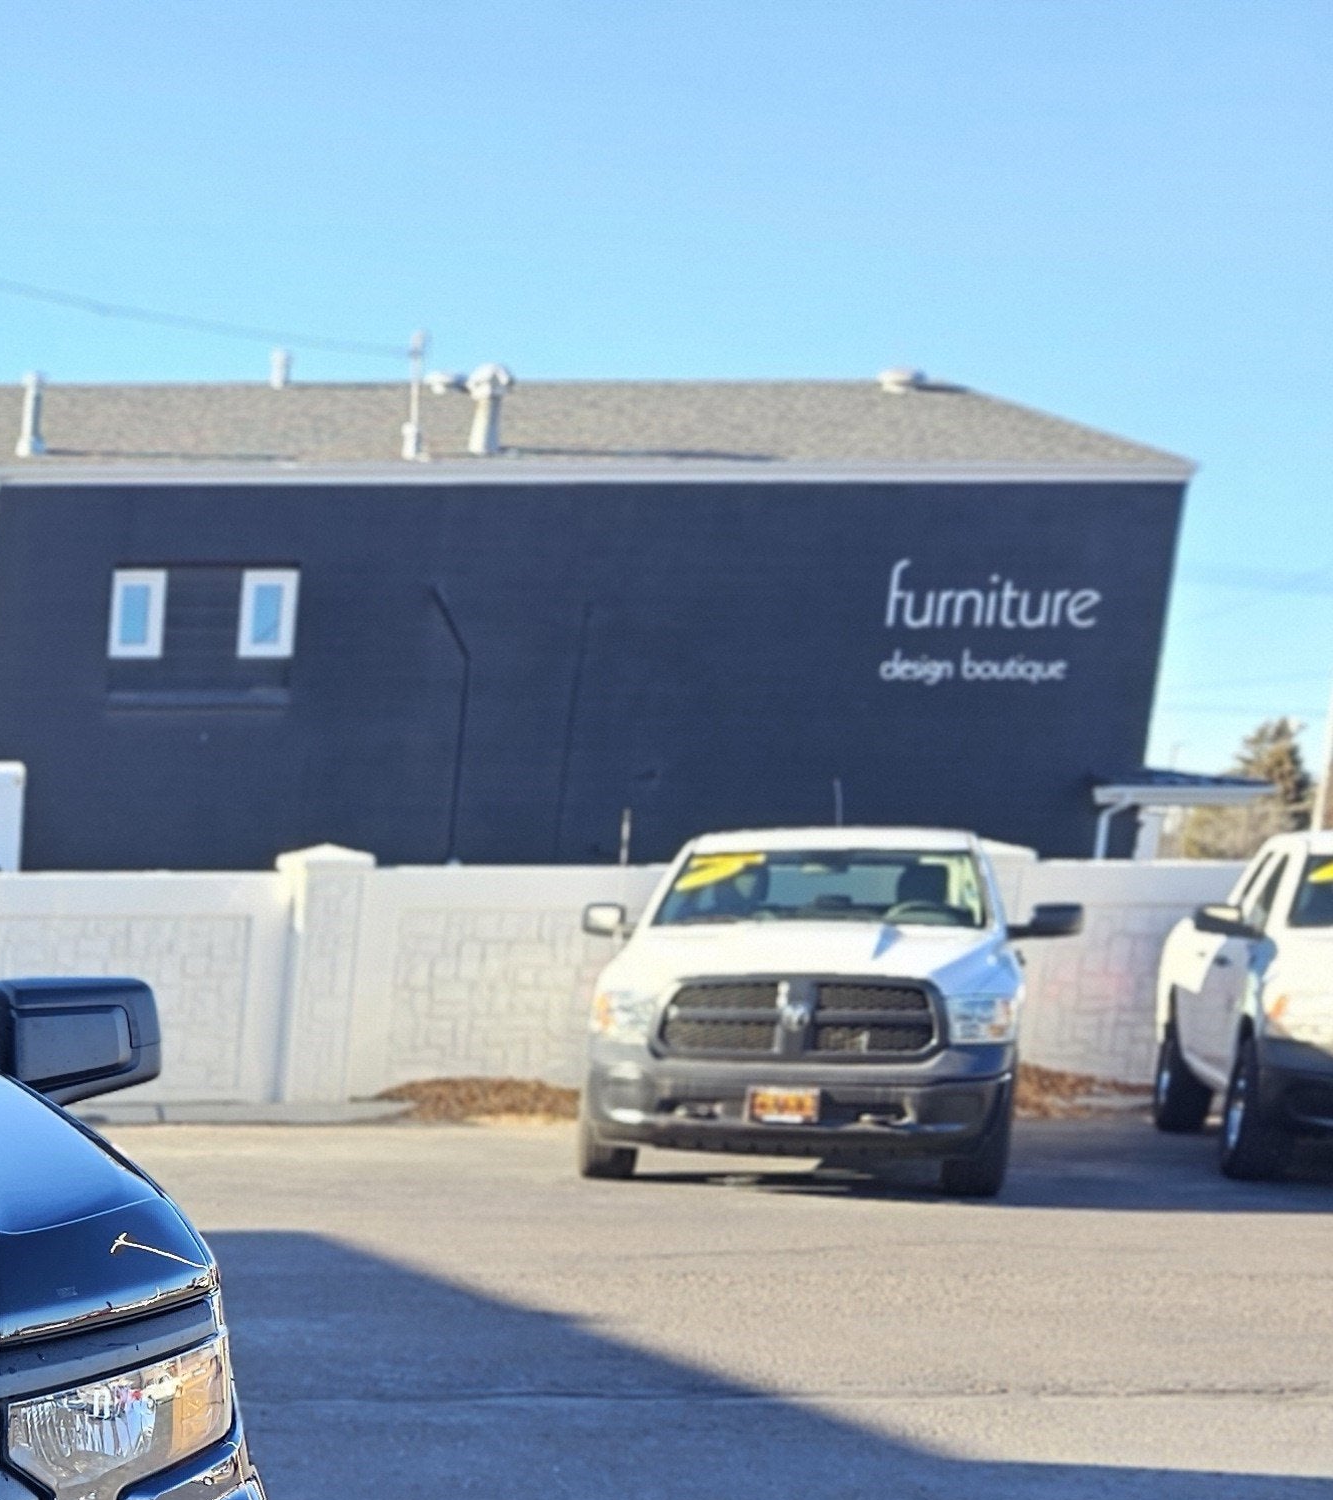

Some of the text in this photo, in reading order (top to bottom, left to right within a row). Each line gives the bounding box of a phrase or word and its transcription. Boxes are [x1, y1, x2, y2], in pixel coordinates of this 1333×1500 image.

[884, 557, 1102, 628] furniture
[879, 649, 1068, 685] design boutique
